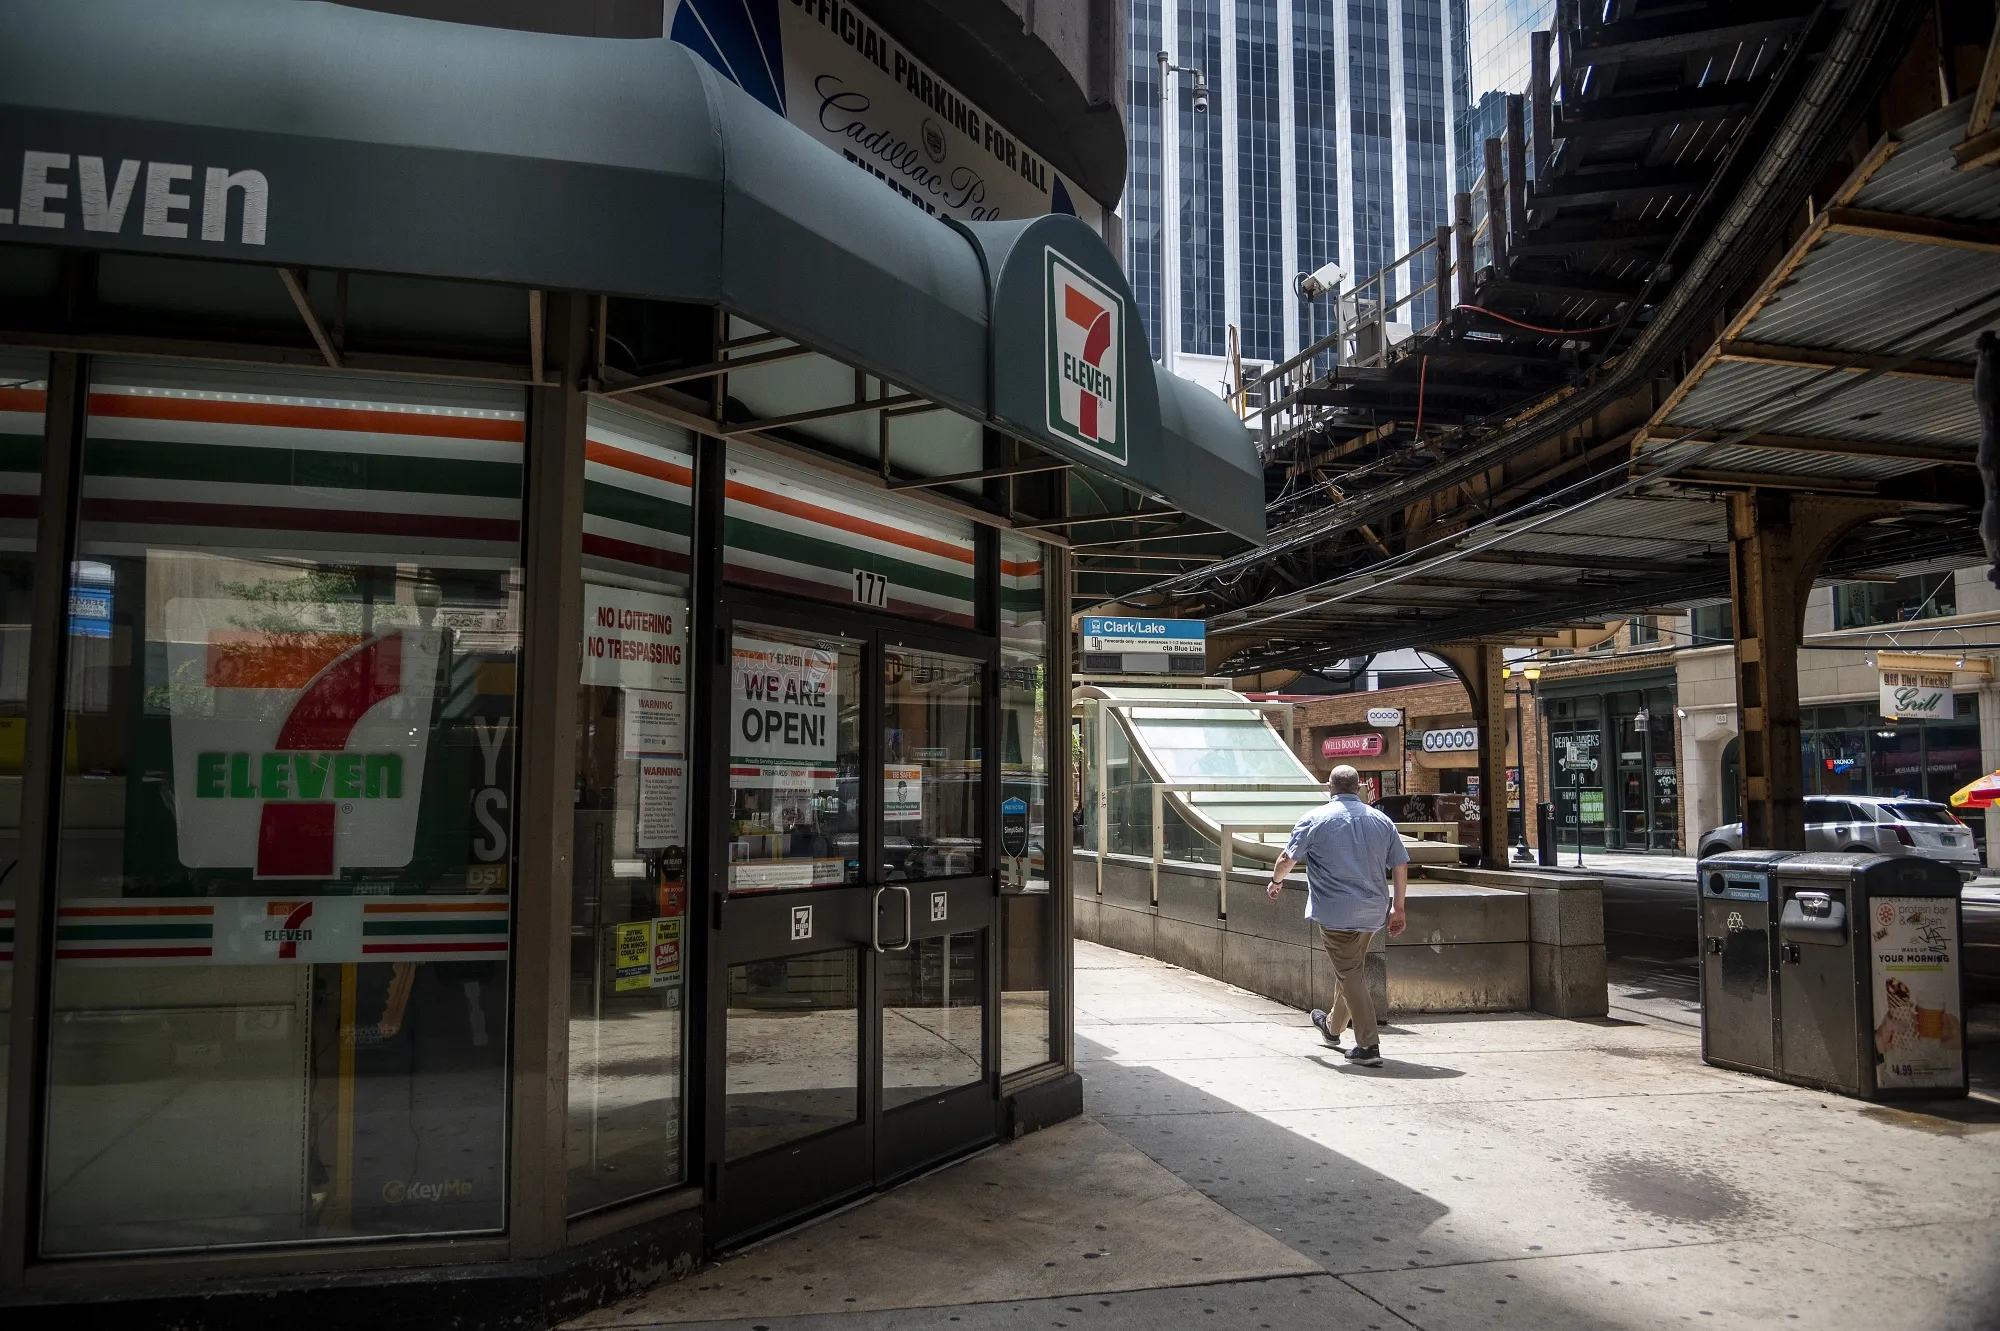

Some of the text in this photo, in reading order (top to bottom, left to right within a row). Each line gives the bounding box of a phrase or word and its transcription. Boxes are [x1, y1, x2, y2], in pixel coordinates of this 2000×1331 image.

[790, 0, 1049, 195] FICIAL PARKING FOR ALL
[814, 74, 942, 195] Cadillac
[856, 571, 886, 605] 177
[598, 606, 672, 635] NO LOITERING
[1103, 620, 1166, 635] Clark/Lake
[588, 636, 681, 665] NO TRESPASSING
[743, 672, 826, 708] WE ARE
[638, 698, 673, 710] WARNING
[1894, 687, 1943, 711] Grill
[742, 707, 826, 746] OPEN!
[1341, 739, 1360, 749] BOOKS
[643, 766, 683, 777] WARNING
[892, 771, 912, 779] BE SAFE
[1571, 772, 1585, 785] PB
[1459, 797, 1480, 813] Office
[1899, 904, 1949, 914] protein bar
[659, 944, 675, 955] We
[656, 952, 678, 965] Card
[1878, 955, 1950, 963] YOUR MORNING
[406, 1179, 472, 1202] KeyMe
